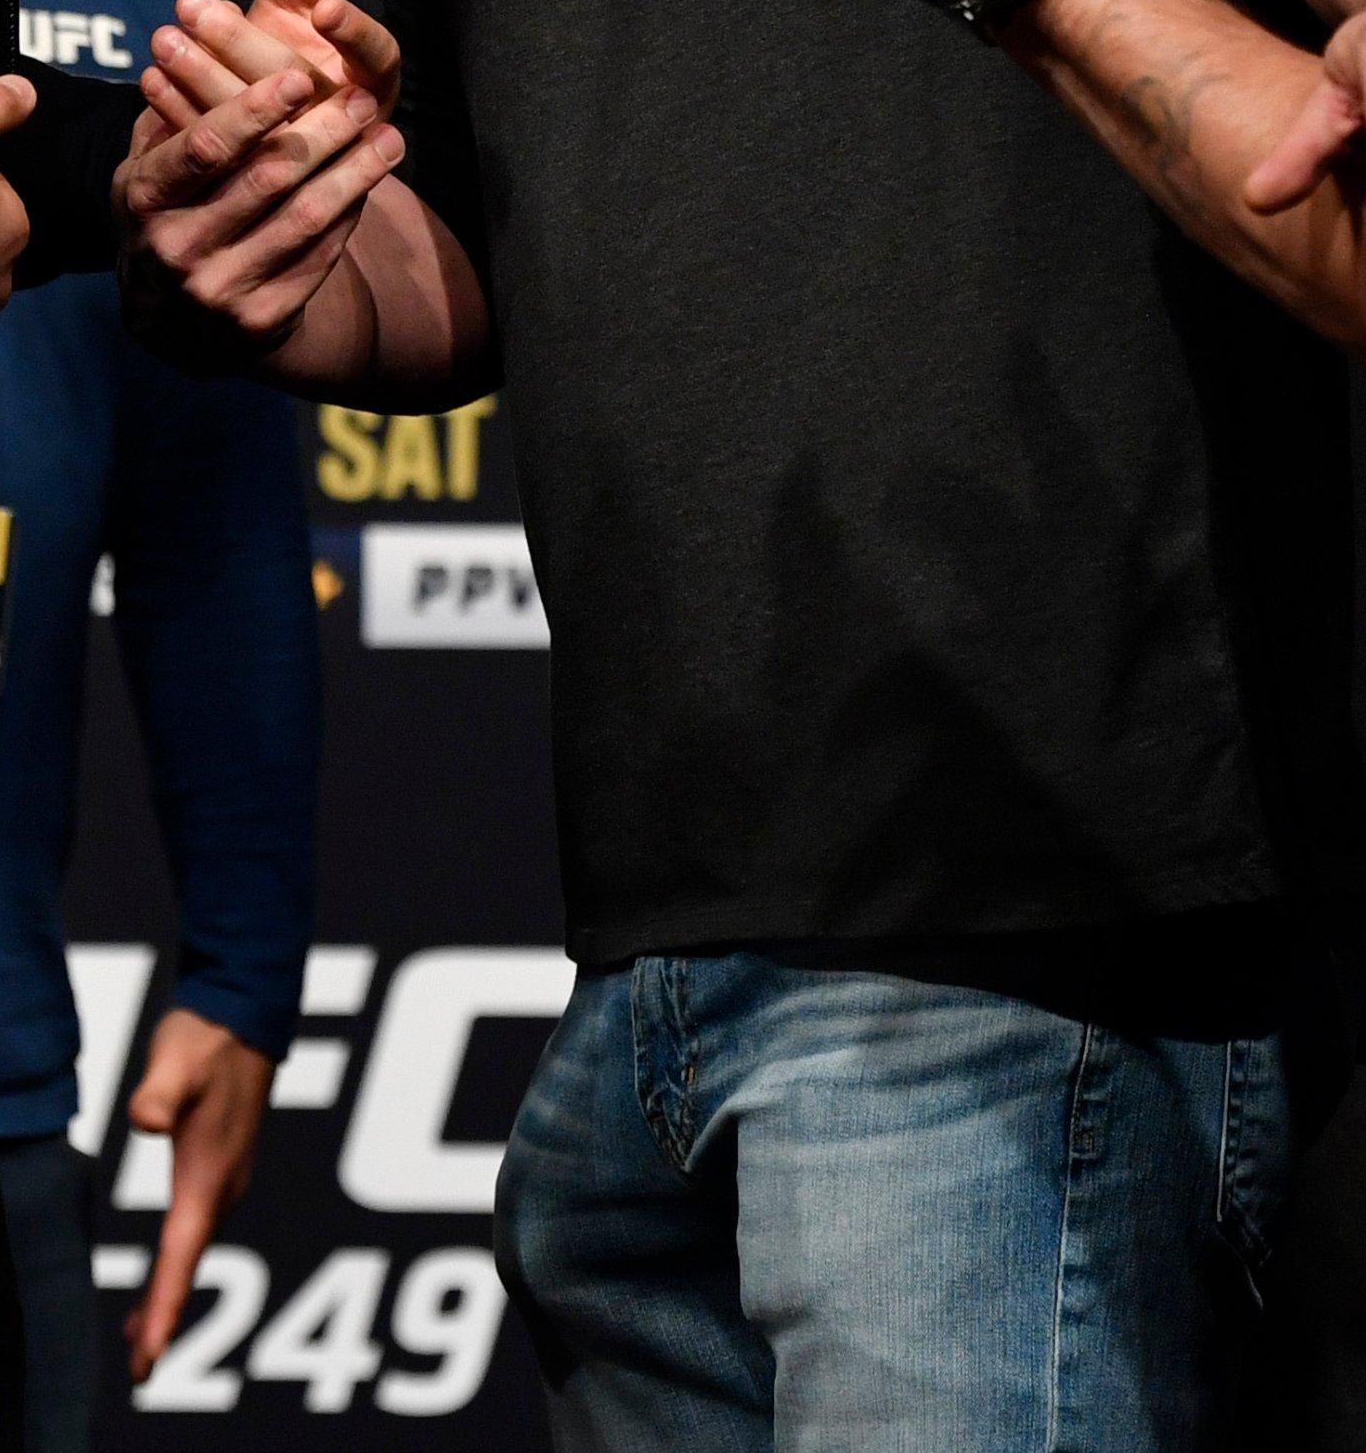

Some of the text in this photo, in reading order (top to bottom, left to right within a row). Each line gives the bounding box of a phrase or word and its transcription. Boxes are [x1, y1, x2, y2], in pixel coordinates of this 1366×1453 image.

[19, 8, 134, 68] UFC
[316, 396, 496, 502] SAT
[133, 1245, 509, 1417] 249
